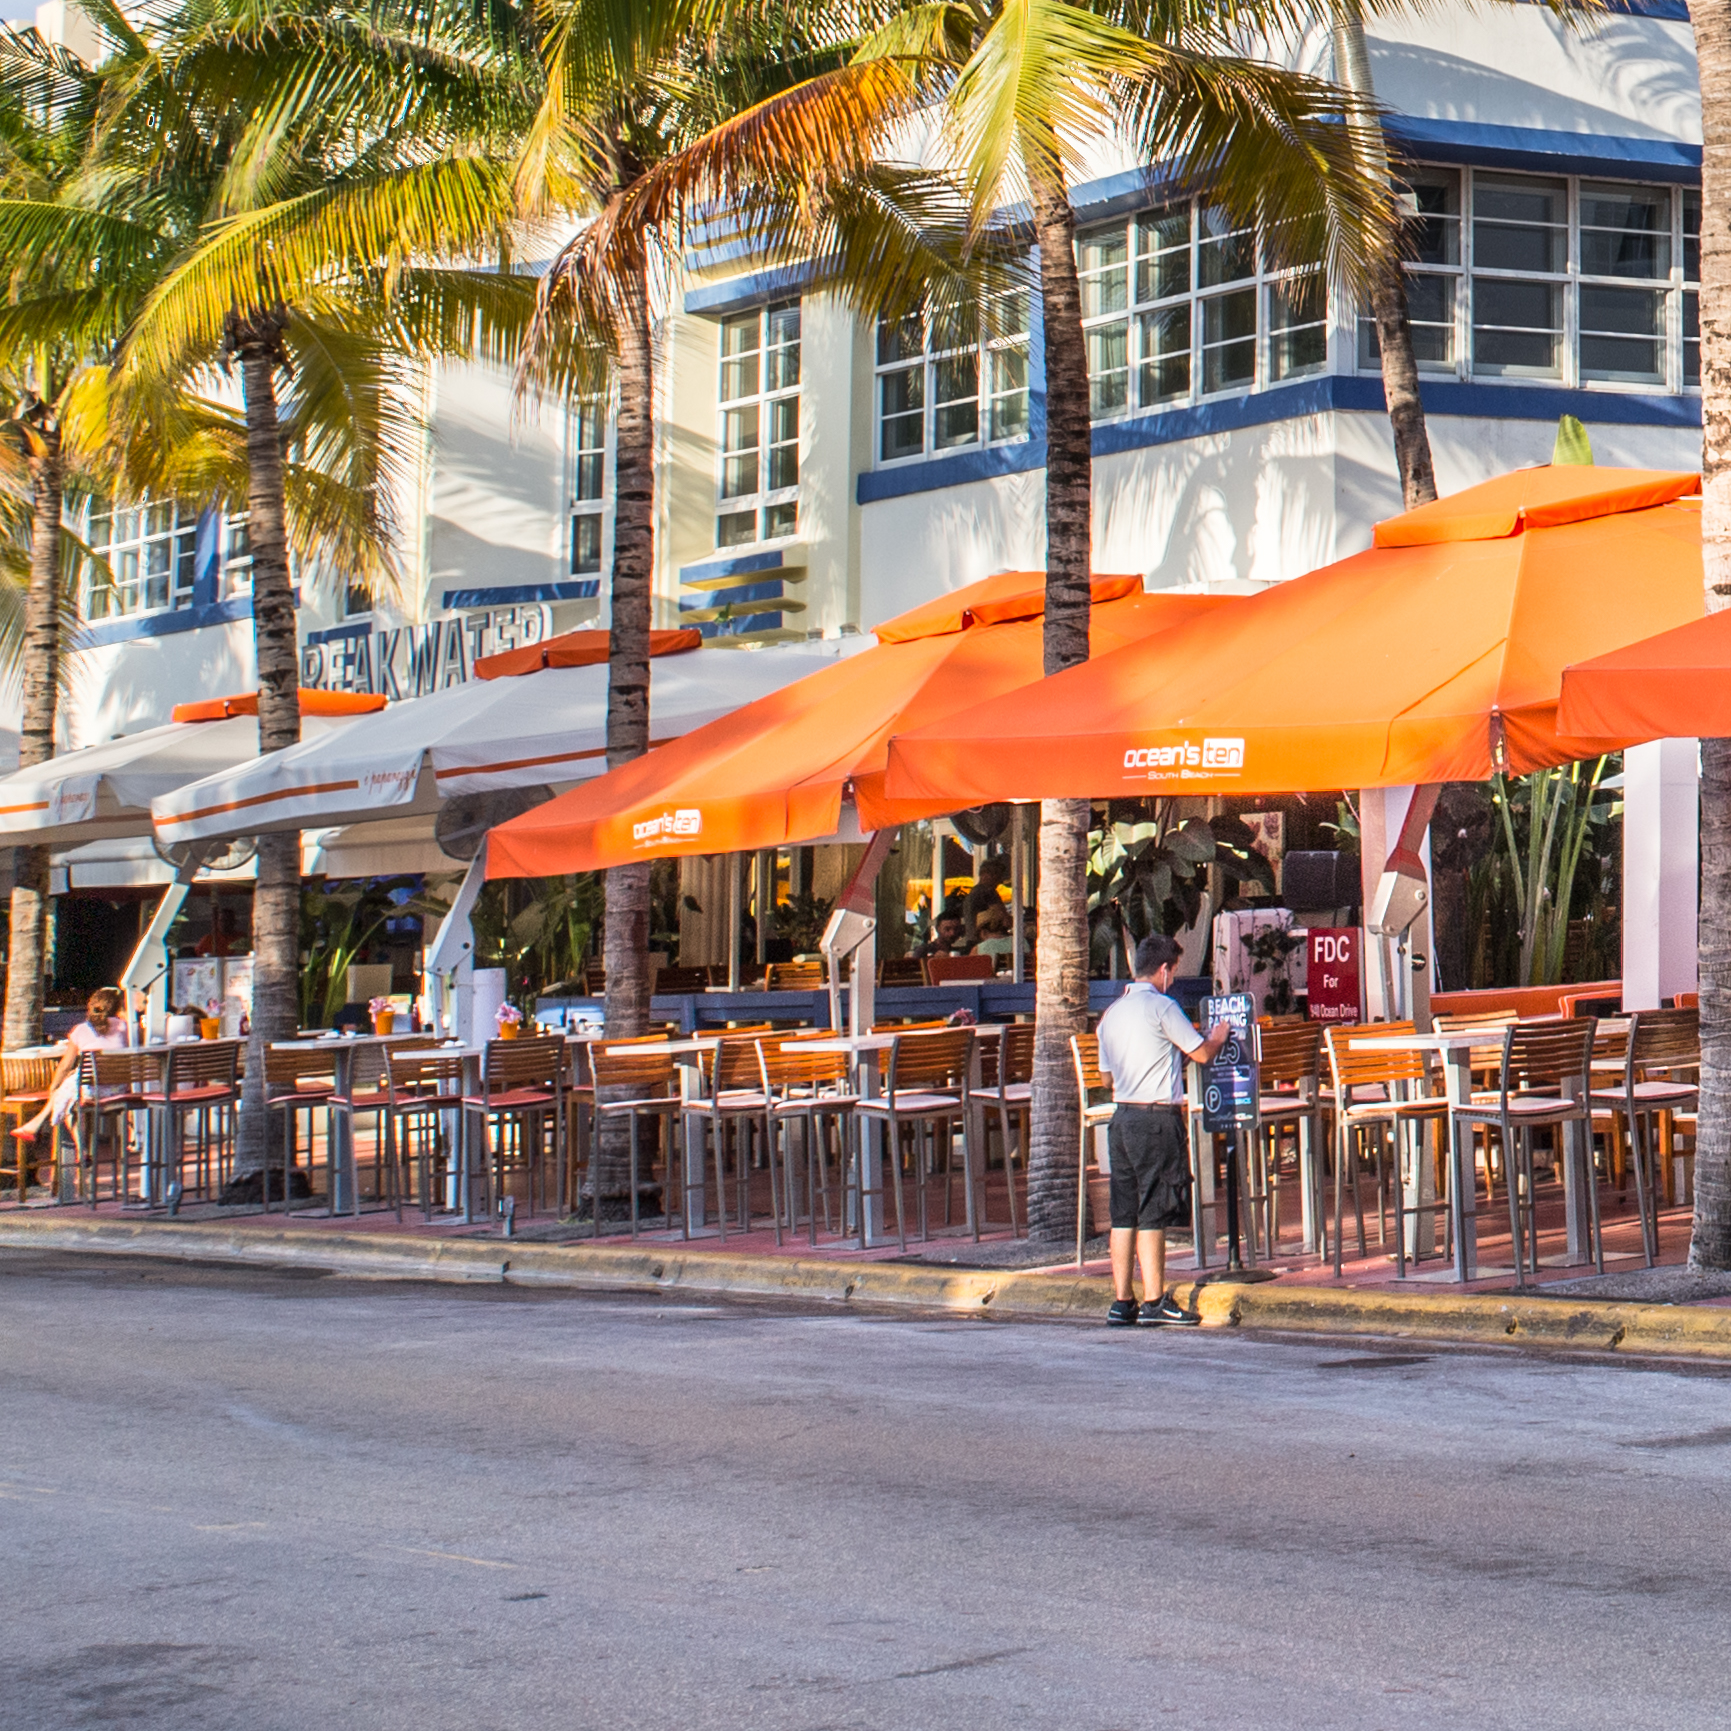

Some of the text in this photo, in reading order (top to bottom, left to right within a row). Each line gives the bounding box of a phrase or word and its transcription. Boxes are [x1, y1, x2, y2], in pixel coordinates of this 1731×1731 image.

[301, 603, 553, 700] REAKWATER
[1123, 739, 1243, 768] ocean's ten
[1314, 935, 1350, 963] FDC
[1323, 974, 1339, 988] For
[1208, 996, 1246, 1015] BEACH
[1340, 1003, 1358, 1018] Drive
